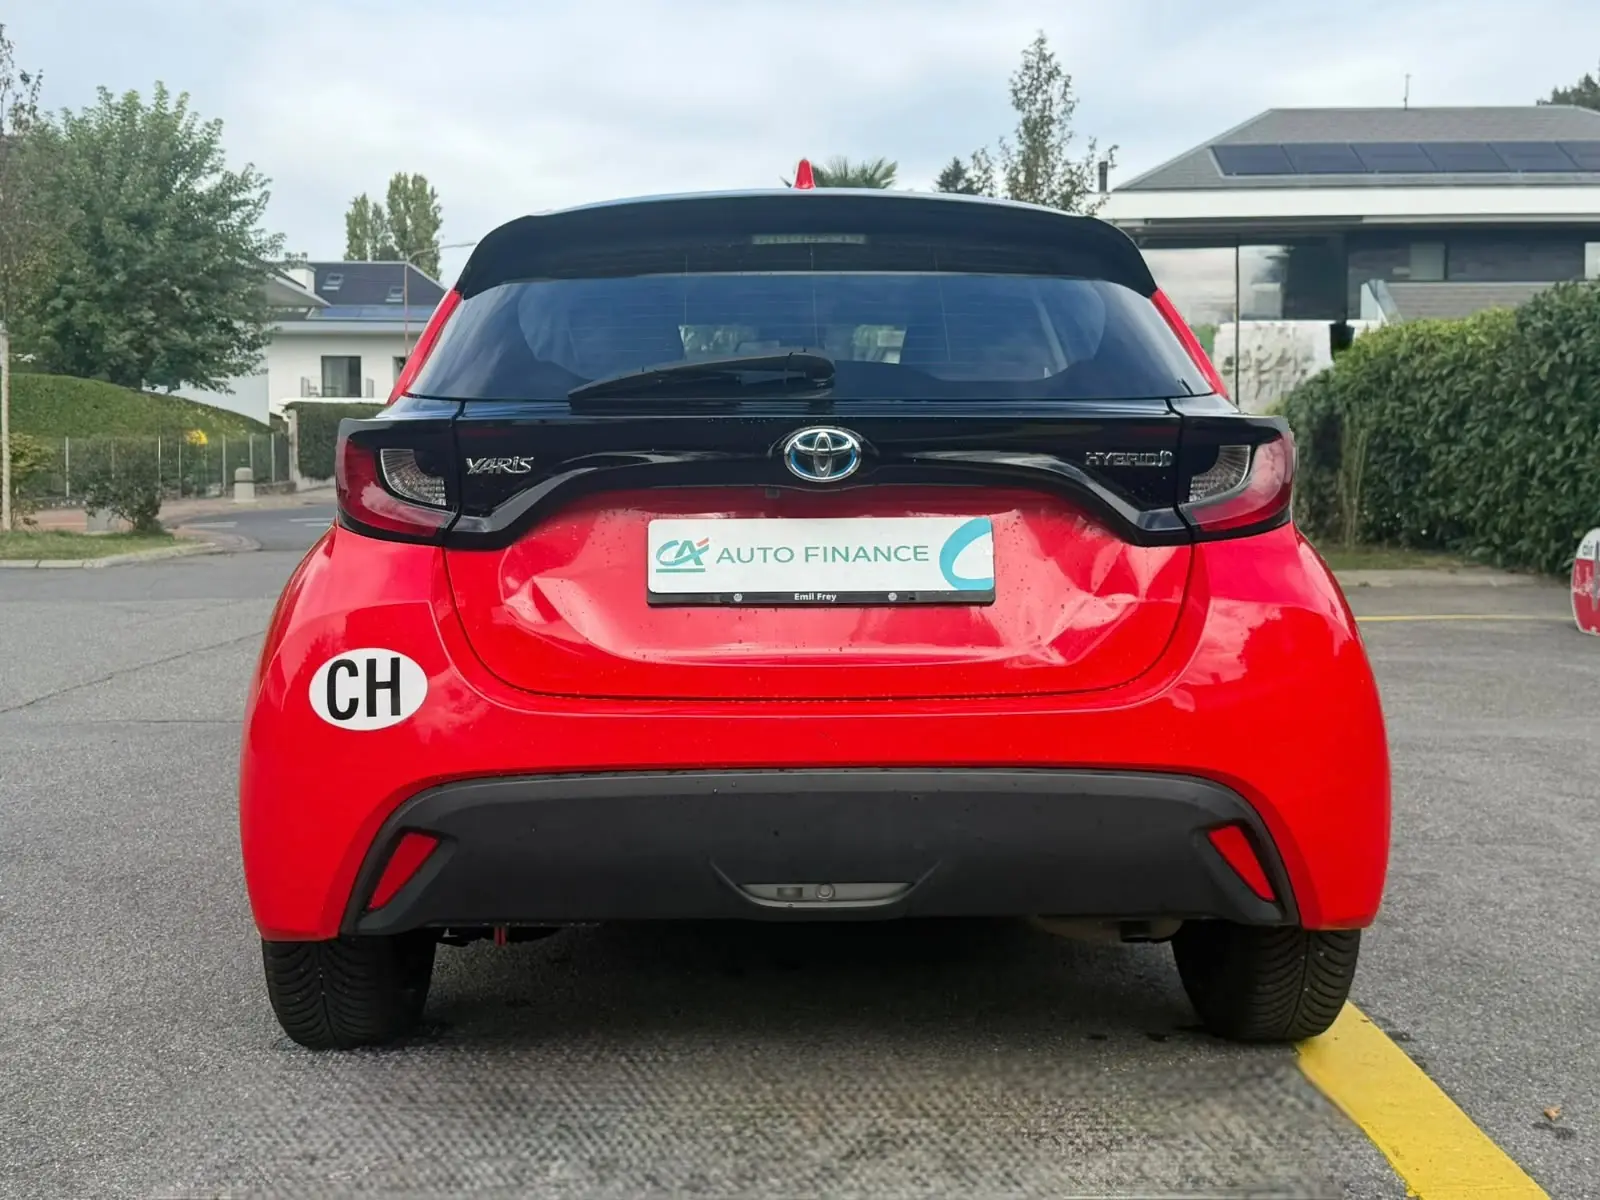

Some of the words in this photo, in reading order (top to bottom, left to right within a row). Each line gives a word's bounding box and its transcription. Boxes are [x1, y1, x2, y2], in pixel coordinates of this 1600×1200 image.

[1085, 451, 1159, 466] HYBRID
[716, 547, 795, 564] AUTO
[804, 545, 929, 563] FINANCE
[794, 592, 815, 601] Emil
[817, 592, 837, 602] Frey
[326, 657, 401, 721] CH
